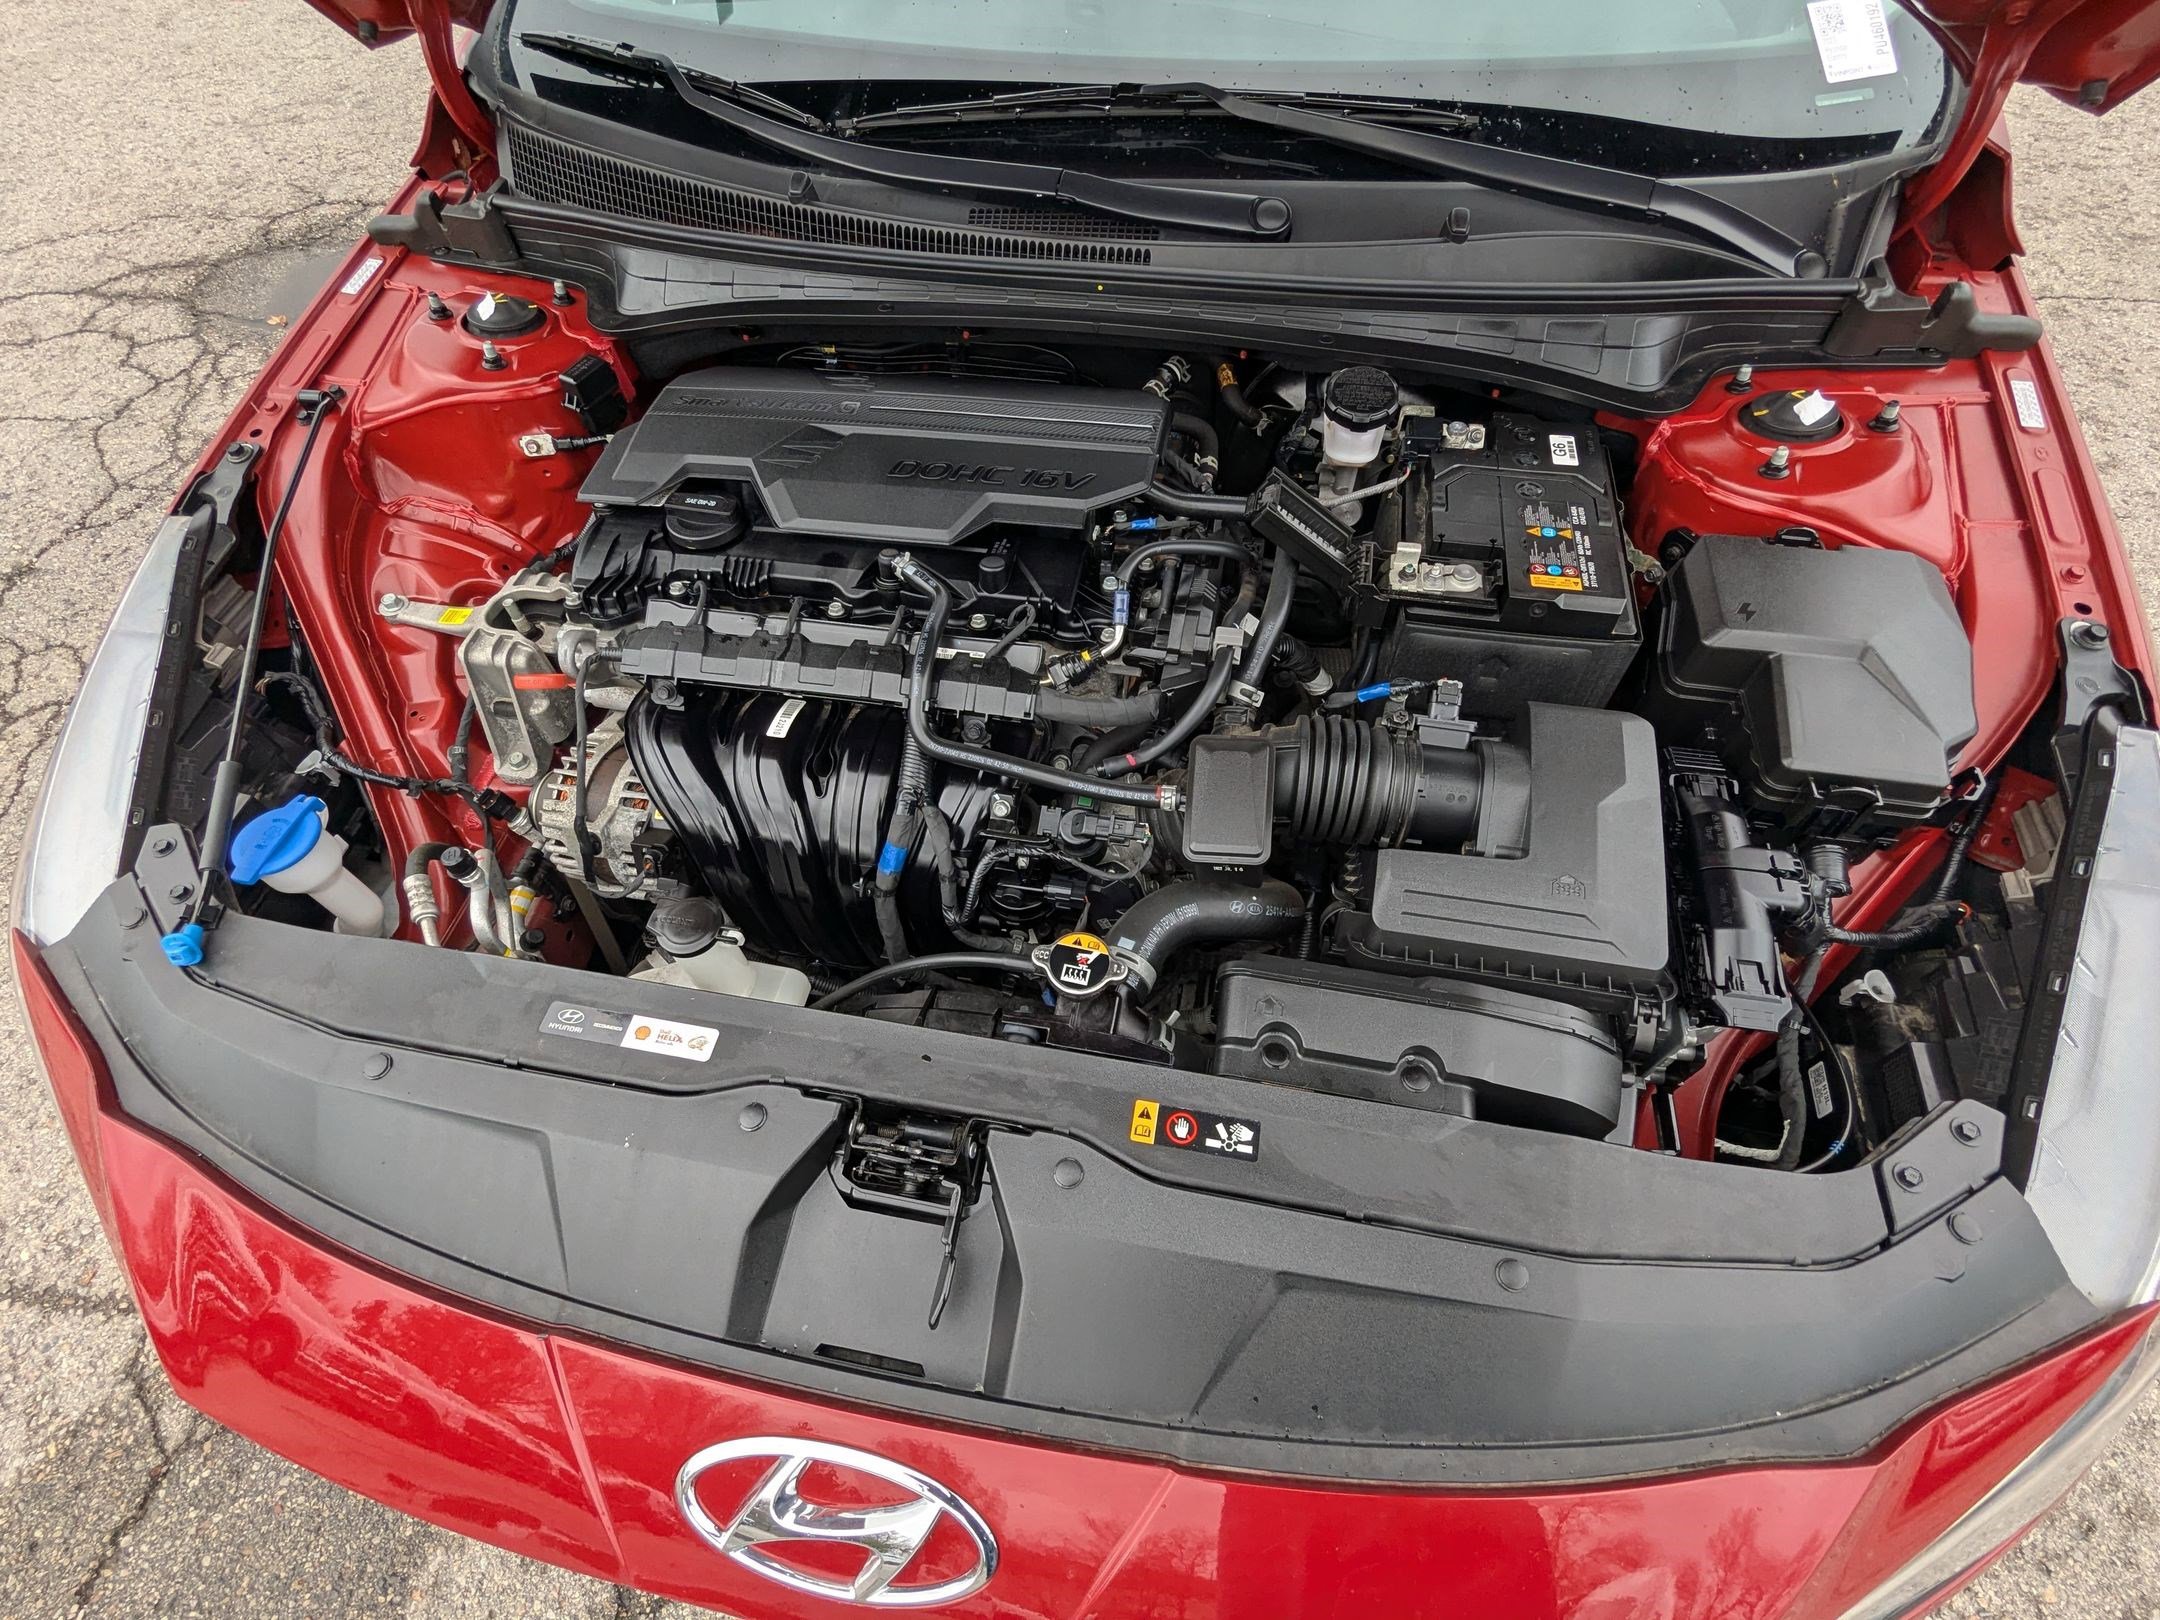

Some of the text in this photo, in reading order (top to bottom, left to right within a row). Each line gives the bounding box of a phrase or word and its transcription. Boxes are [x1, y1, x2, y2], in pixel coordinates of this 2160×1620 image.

[1865, 3, 1889, 55] PU460192
[673, 393, 832, 413] Smartstream
[1553, 442, 1567, 457] G6
[887, 459, 1097, 490] DOHC 16V
[685, 497, 698, 505] SAE
[1034, 950, 1050, 960] HCC
[1113, 964, 1125, 974] 1.1
[548, 1022, 584, 1034] HYUNDAI
[657, 1033, 683, 1044] HELIX
